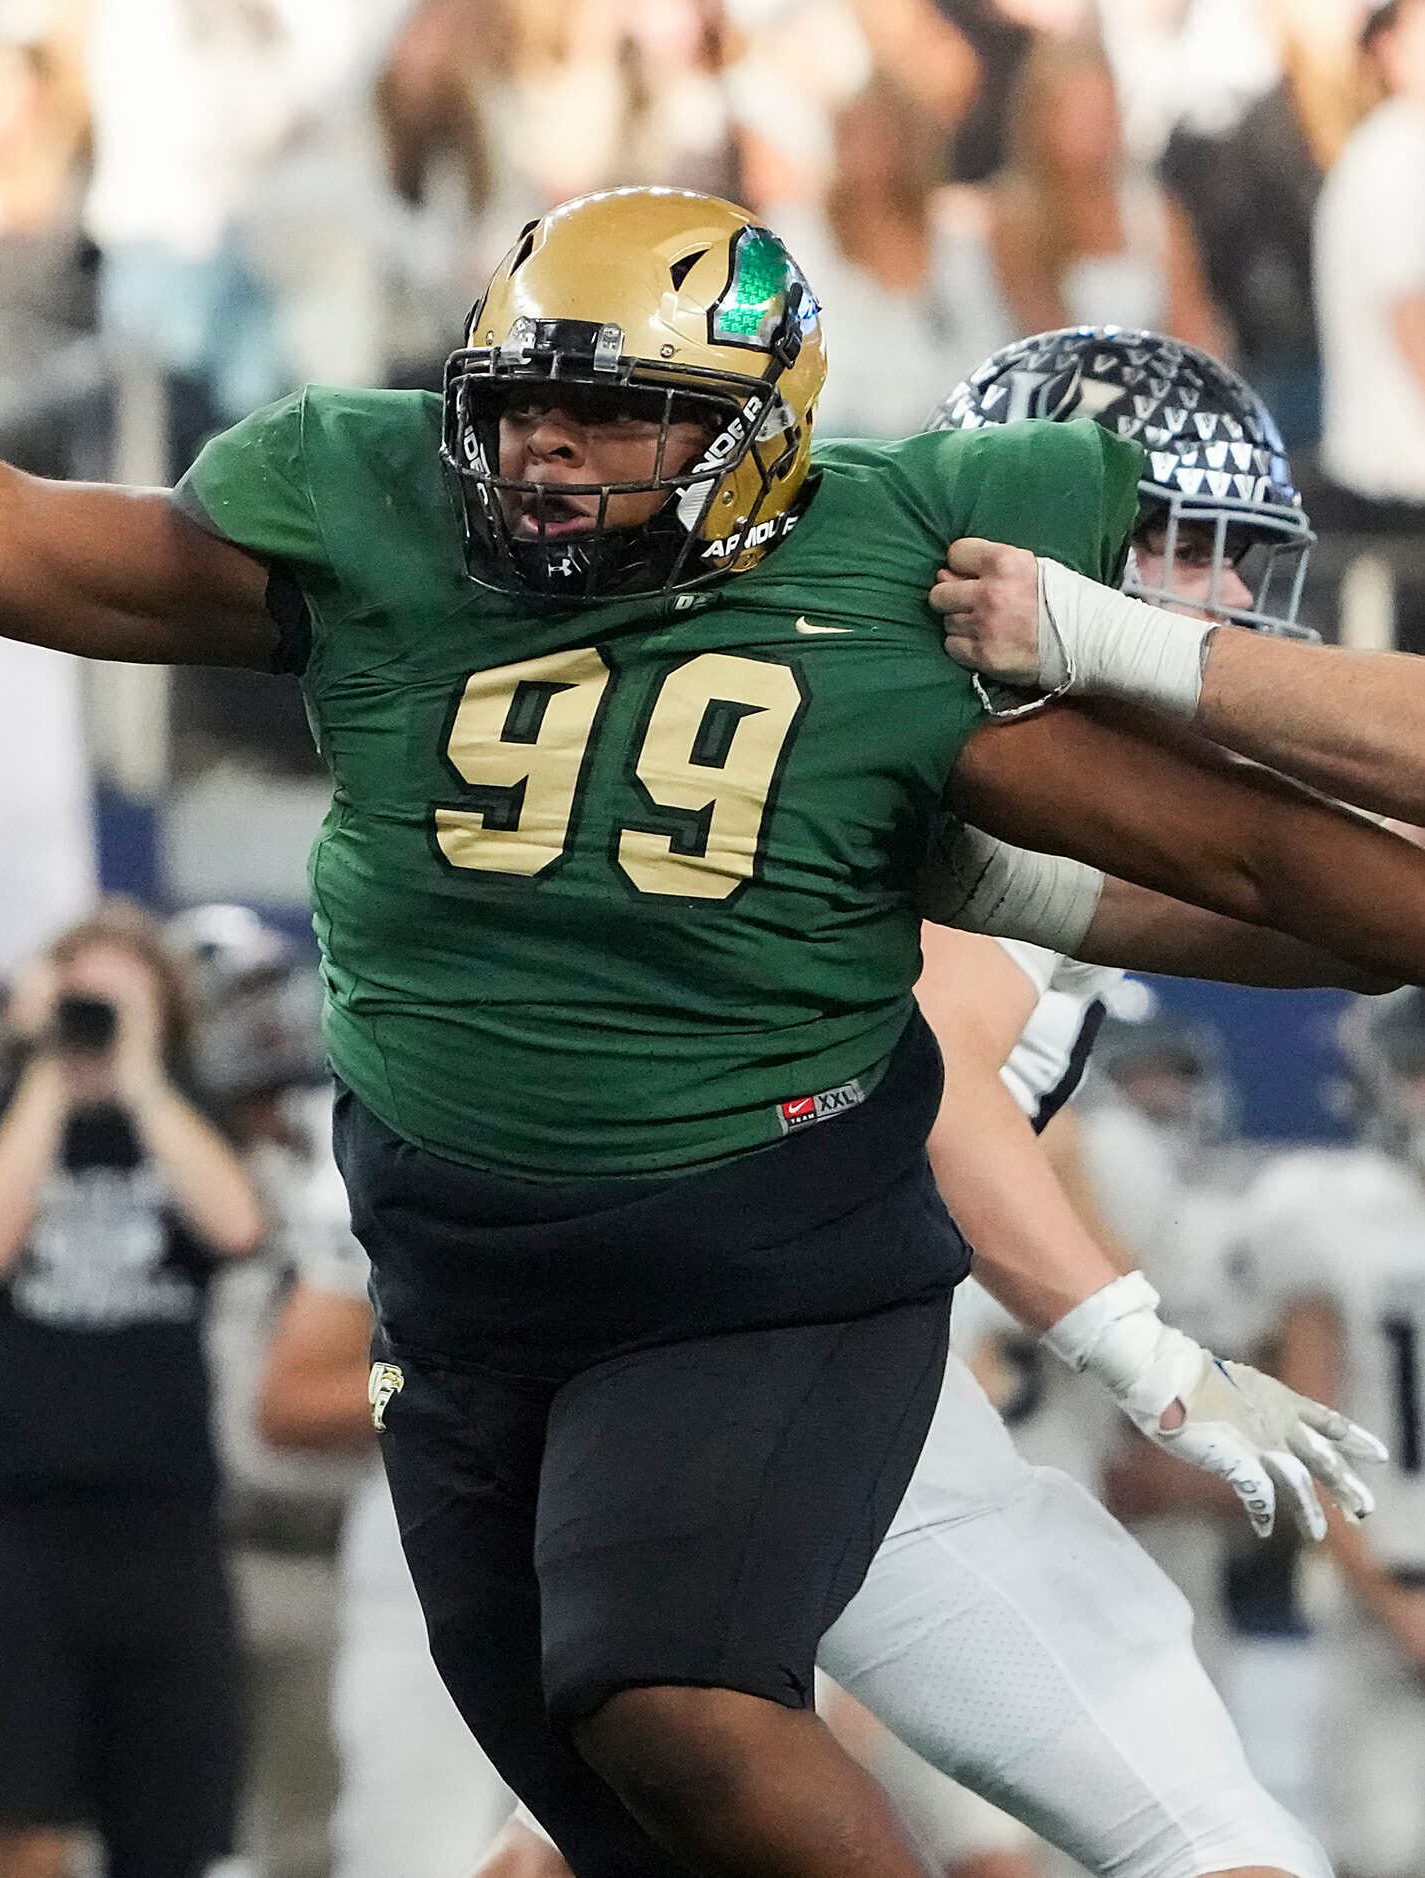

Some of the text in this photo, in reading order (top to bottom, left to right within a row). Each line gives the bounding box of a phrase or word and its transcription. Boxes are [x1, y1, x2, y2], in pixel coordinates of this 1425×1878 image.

[435, 647, 802, 900] 99
[818, 1090, 854, 1111] XXL
[790, 1113, 814, 1124] TEAM
